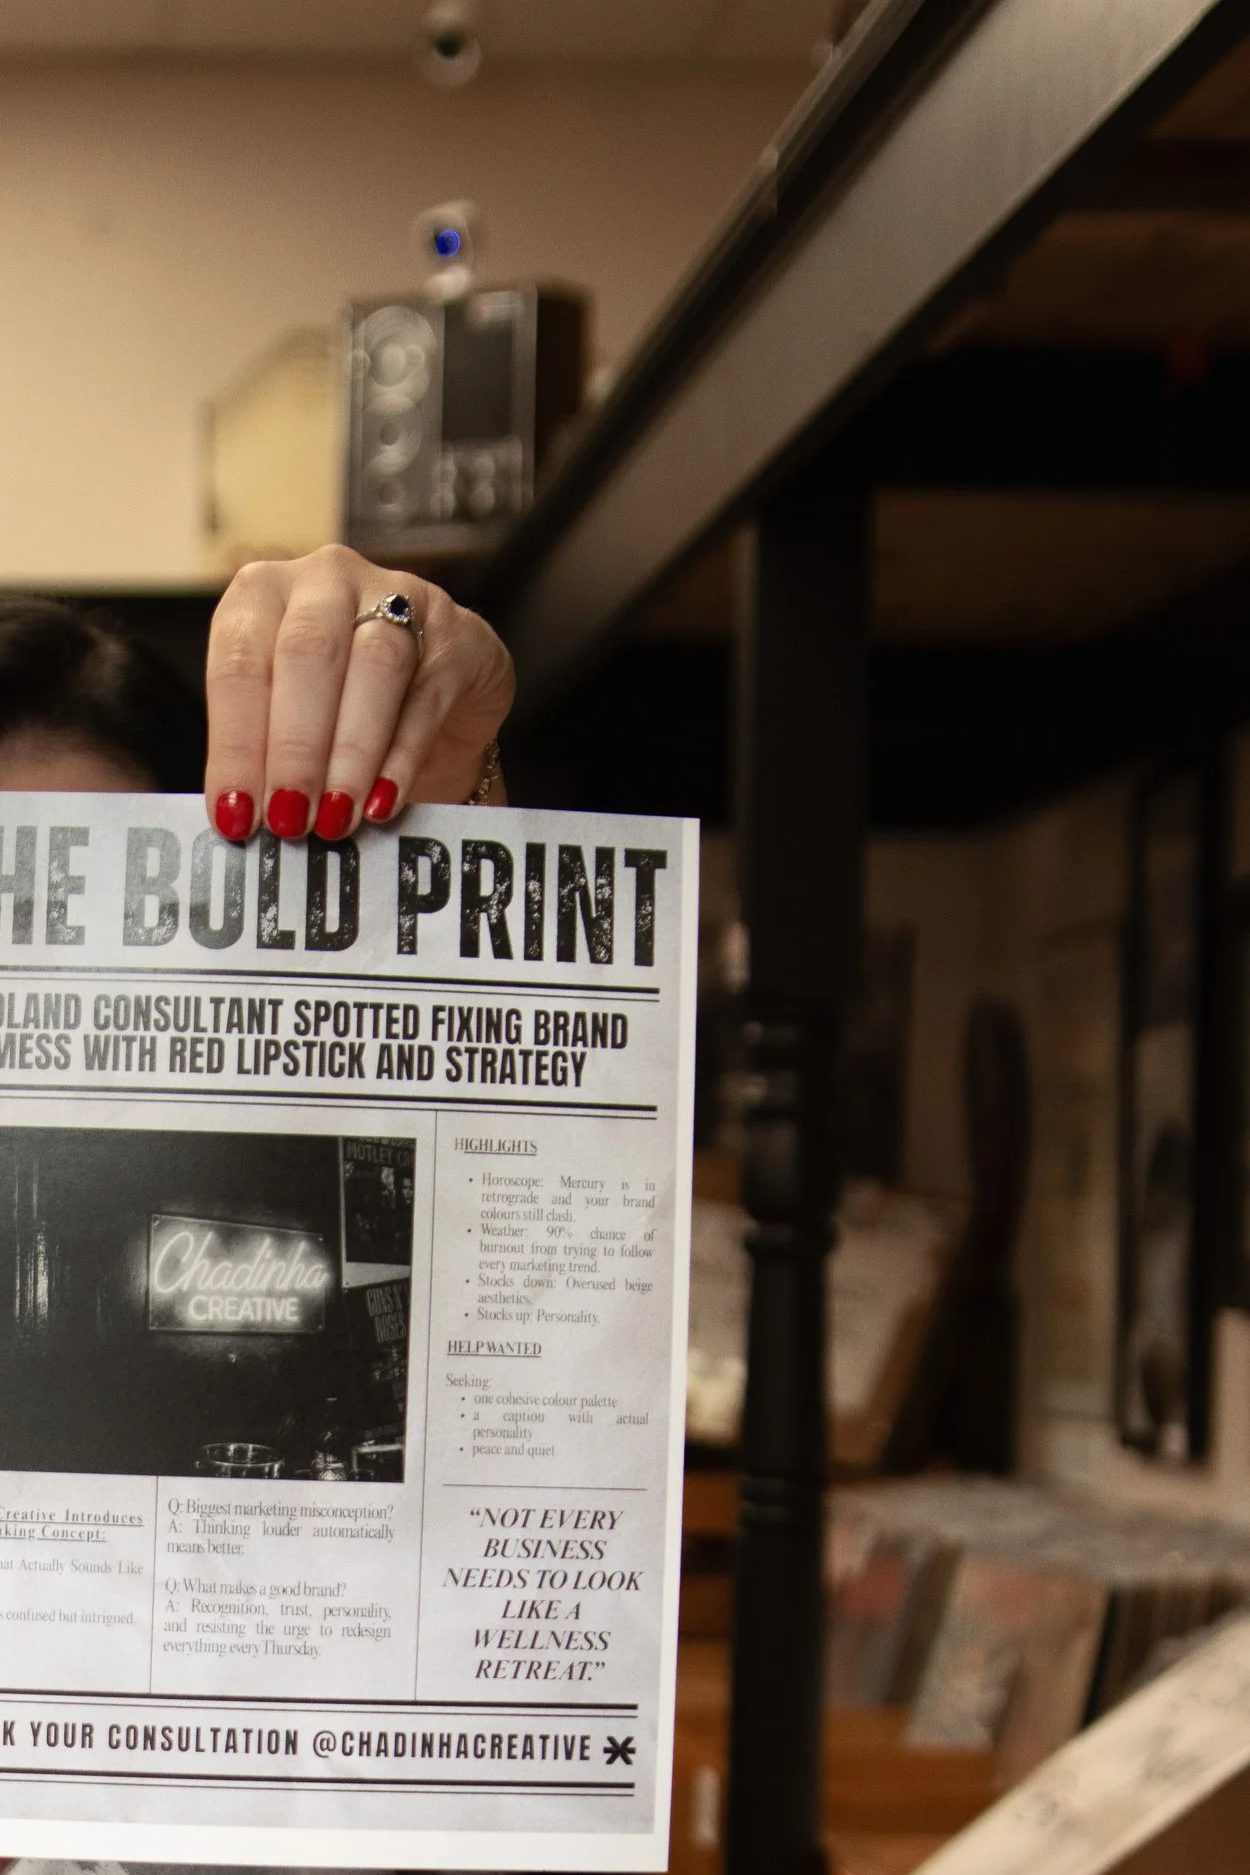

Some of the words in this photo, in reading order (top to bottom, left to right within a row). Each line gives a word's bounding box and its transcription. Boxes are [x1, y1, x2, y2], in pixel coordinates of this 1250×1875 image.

[123, 827, 360, 952] BOLD
[397, 836, 667, 967] PRINT
[94, 994, 284, 1035] CONSULTANT
[294, 999, 420, 1041] SPOTTED
[432, 1005, 523, 1045] FIXING
[534, 1010, 628, 1049] BRAND
[83, 1034, 158, 1072] WITH
[170, 1037, 225, 1074] RED
[237, 1038, 366, 1079] LIPSTICK
[376, 1043, 435, 1081] AND
[446, 1047, 588, 1087] STRATEGY
[454, 1137, 538, 1154] HIGHLIGHTS
[482, 1172, 544, 1189] Horoscope:
[560, 1175, 605, 1191] Mercury
[621, 1178, 630, 1190] is
[645, 1178, 655, 1191] in
[482, 1192, 539, 1205] retrograde
[551, 1193, 572, 1206] and
[585, 1195, 609, 1209] your
[623, 1195, 655, 1208] brand
[481, 1208, 521, 1220] colours
[523, 1208, 543, 1221] still
[546, 1209, 576, 1222] clash.
[481, 1224, 529, 1238] Weather:
[547, 1225, 573, 1239] 90%
[590, 1227, 626, 1241] chance
[643, 1228, 657, 1241] of
[480, 1240, 524, 1253] burnout
[531, 1242, 557, 1255] from
[563, 1243, 597, 1258] trying
[603, 1244, 615, 1257] to
[620, 1244, 654, 1258] follow
[154, 1231, 329, 1293] Chadinha
[479, 1260, 505, 1273] every
[509, 1258, 565, 1275] marketing
[569, 1260, 600, 1273] trend.
[478, 1274, 514, 1287] Stocks
[566, 1276, 616, 1290] Overused
[625, 1278, 653, 1294] beige
[478, 1292, 532, 1305] aesthetics.
[188, 1295, 301, 1321] CREATIVE
[478, 1307, 514, 1321] Stocks
[537, 1308, 600, 1325] Personality.
[447, 1340, 484, 1354] HELP
[486, 1341, 542, 1355] WANTED
[446, 1373, 493, 1390] Seeking:
[474, 1394, 494, 1404] one
[496, 1392, 540, 1405] cohesive
[542, 1393, 578, 1406] colour
[580, 1395, 617, 1409] palette
[473, 1412, 480, 1421] a
[503, 1409, 545, 1424] caption
[568, 1410, 593, 1424] with
[616, 1412, 649, 1425] actual
[473, 1426, 534, 1440] personality
[472, 1444, 502, 1457] peace
[504, 1443, 525, 1456] and
[527, 1445, 555, 1459] quiet
[66, 1509, 143, 1524] Introduces
[186, 1500, 230, 1518] Biggest
[234, 1501, 297, 1519] marketing
[300, 1503, 393, 1521] misconception?
[540, 1509, 623, 1530] EVERY
[42, 1525, 107, 1542] Concept:
[193, 1519, 250, 1537] Thinking
[262, 1521, 302, 1536] louder
[313, 1523, 395, 1543] automatically
[167, 1542, 205, 1554] means
[207, 1539, 245, 1555] better.
[483, 1538, 607, 1560] BUSINESS
[19, 1558, 64, 1574] Actually
[71, 1560, 112, 1574] Sounds
[119, 1561, 143, 1575] Like
[183, 1578, 217, 1593] What
[220, 1579, 257, 1595] makes
[259, 1586, 266, 1596] a
[270, 1581, 300, 1599] good
[304, 1582, 347, 1597] brand?
[442, 1568, 529, 1589] NEEDS
[537, 1569, 568, 1590] TO
[574, 1570, 644, 1591] LOOK
[6, 1607, 55, 1622] confused
[59, 1609, 77, 1623] but
[502, 1600, 562, 1620] LIKE
[565, 1601, 581, 1620] A
[164, 1618, 187, 1632] and
[196, 1620, 246, 1637] resisting
[256, 1621, 275, 1636] the
[284, 1625, 310, 1640] urge
[320, 1624, 333, 1637] to
[342, 1624, 390, 1642] redesign
[163, 1638, 227, 1658] everything
[230, 1642, 260, 1658] every
[261, 1640, 321, 1660] Thursday.
[475, 1629, 611, 1651] WELLNESS
[30, 1721, 95, 1749] YOUR
[108, 1723, 299, 1755] CONSULTATION
[313, 1729, 591, 1761] @CHADINHACREATIVE
